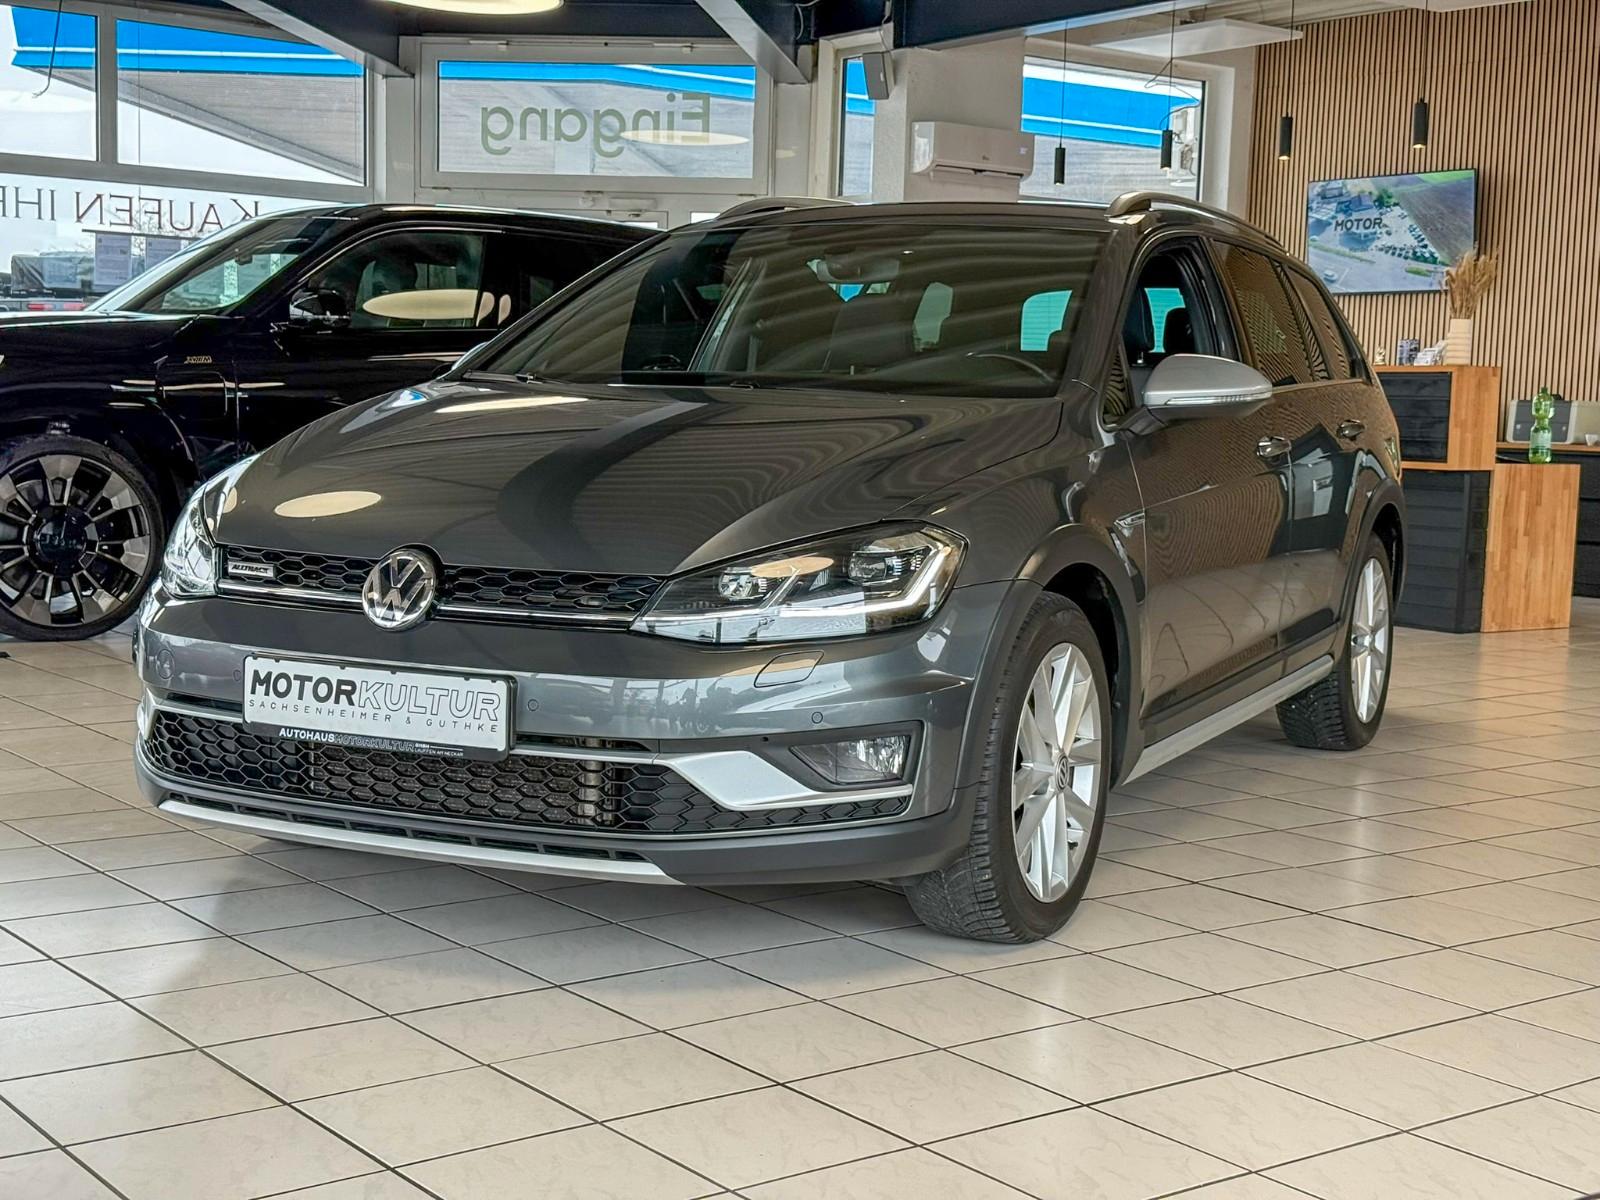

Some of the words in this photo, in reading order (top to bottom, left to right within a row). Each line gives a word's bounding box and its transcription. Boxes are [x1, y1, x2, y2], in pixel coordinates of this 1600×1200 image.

[1334, 217, 1383, 231] MOTOR
[249, 700, 392, 723] SACHSENHEIMER
[405, 716, 412, 725] &
[426, 718, 498, 733] GUTHKE
